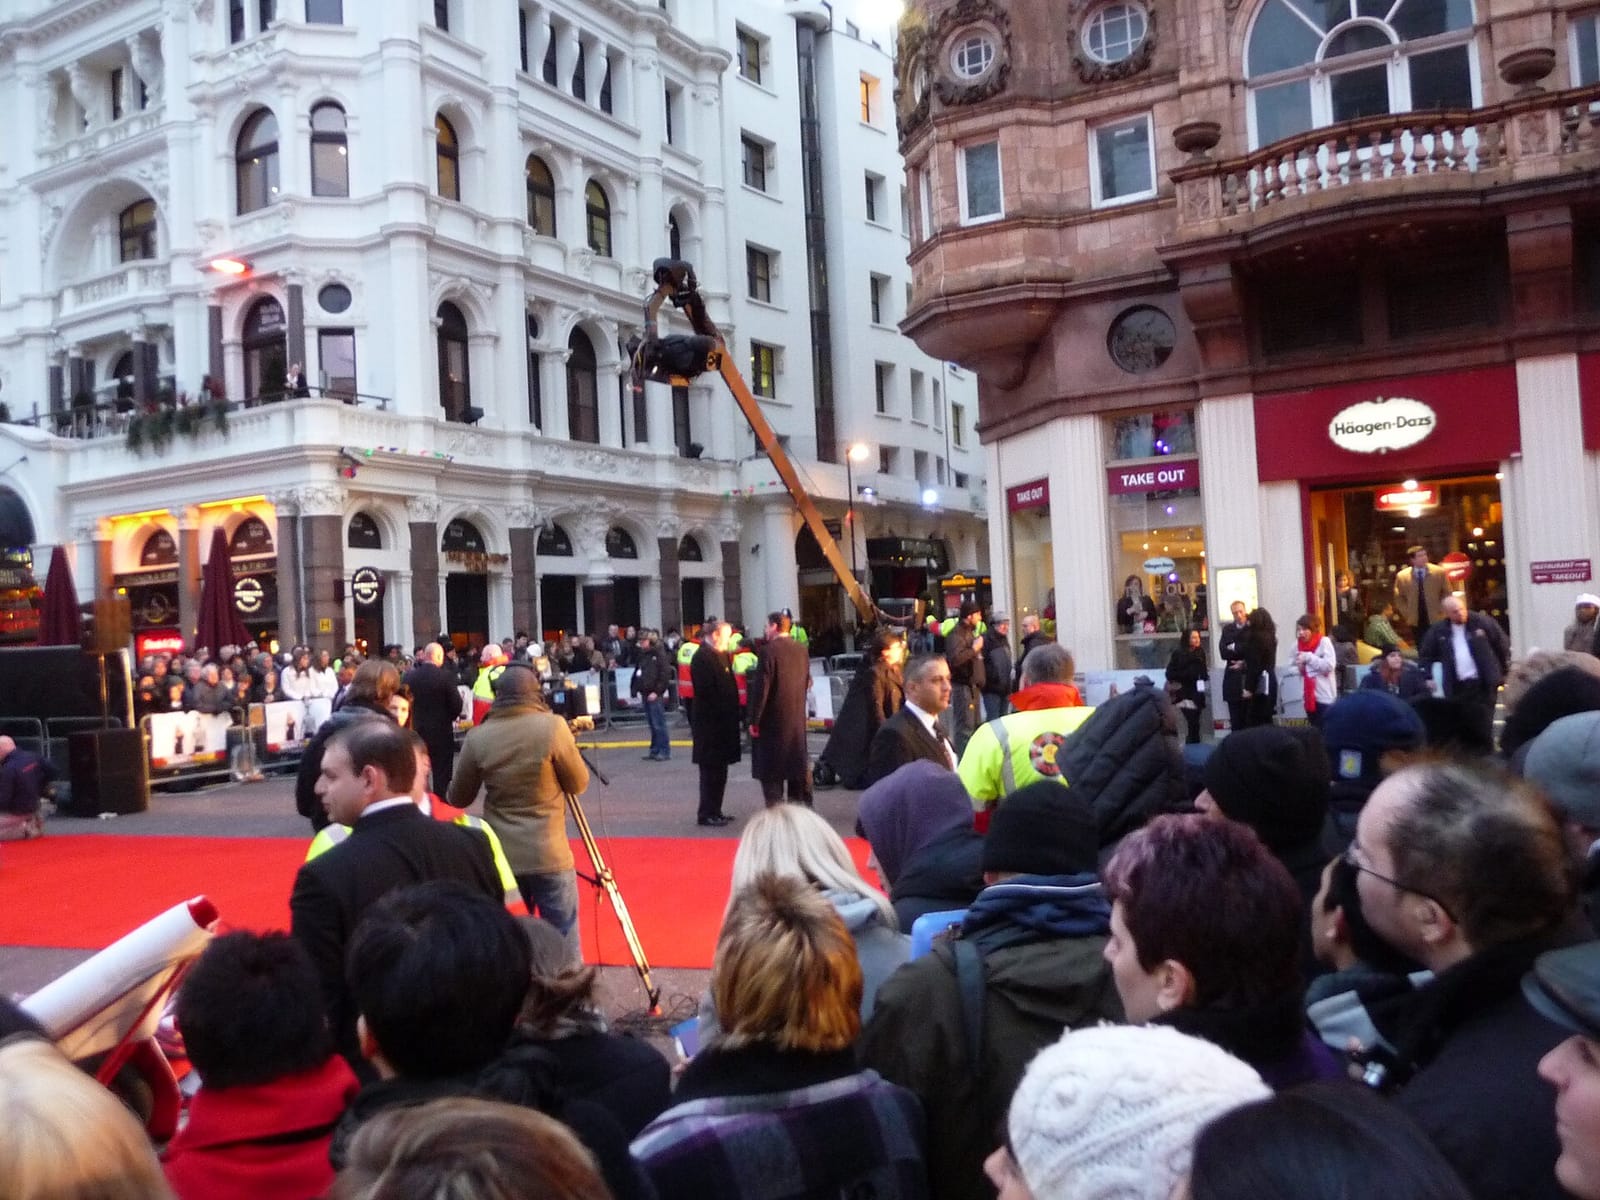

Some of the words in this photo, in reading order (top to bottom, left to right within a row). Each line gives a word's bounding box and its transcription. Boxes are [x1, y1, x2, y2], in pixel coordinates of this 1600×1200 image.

[1334, 415, 1432, 436] Häagen-Dazs
[1121, 472, 1154, 487] TAKE
[1157, 469, 1185, 483] OUT
[1016, 490, 1031, 503] TAKE
[1031, 487, 1043, 500] OUT
